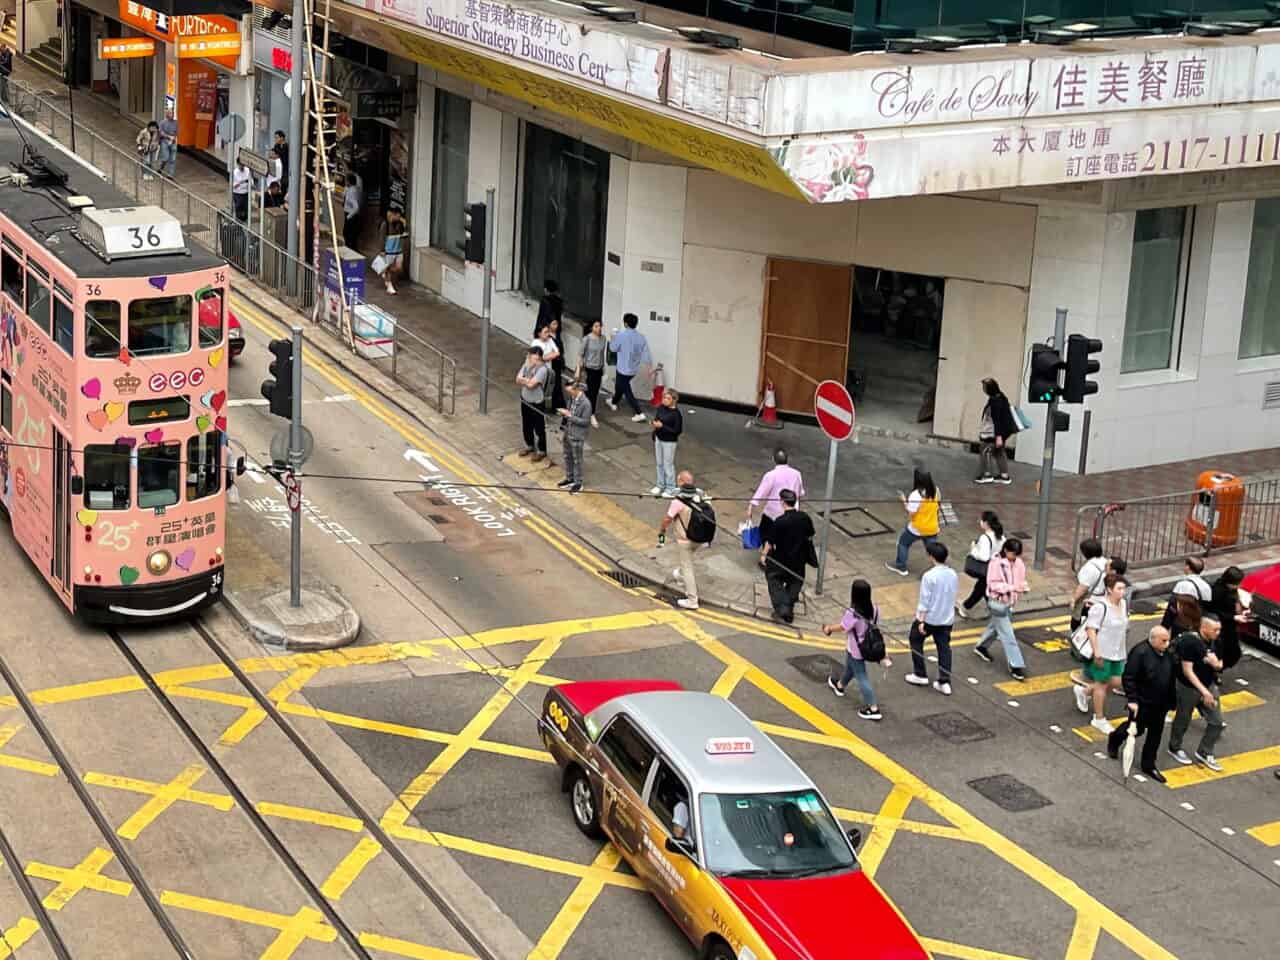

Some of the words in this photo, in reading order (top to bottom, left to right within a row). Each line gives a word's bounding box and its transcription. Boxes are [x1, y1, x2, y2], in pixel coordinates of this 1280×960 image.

[425, 7, 470, 39] Superior
[472, 21, 518, 57] Strategy
[521, 35, 575, 71] Business
[871, 71, 934, 124] Café
[939, 87, 963, 112] de
[1053, 56, 1207, 110] 佳美餐廳
[1066, 152, 1138, 177] 訂座電話
[1140, 131, 1280, 172] 2117-1111
[128, 225, 161, 249] 36
[86, 284, 102, 296] 36
[214, 272, 225, 283] 36
